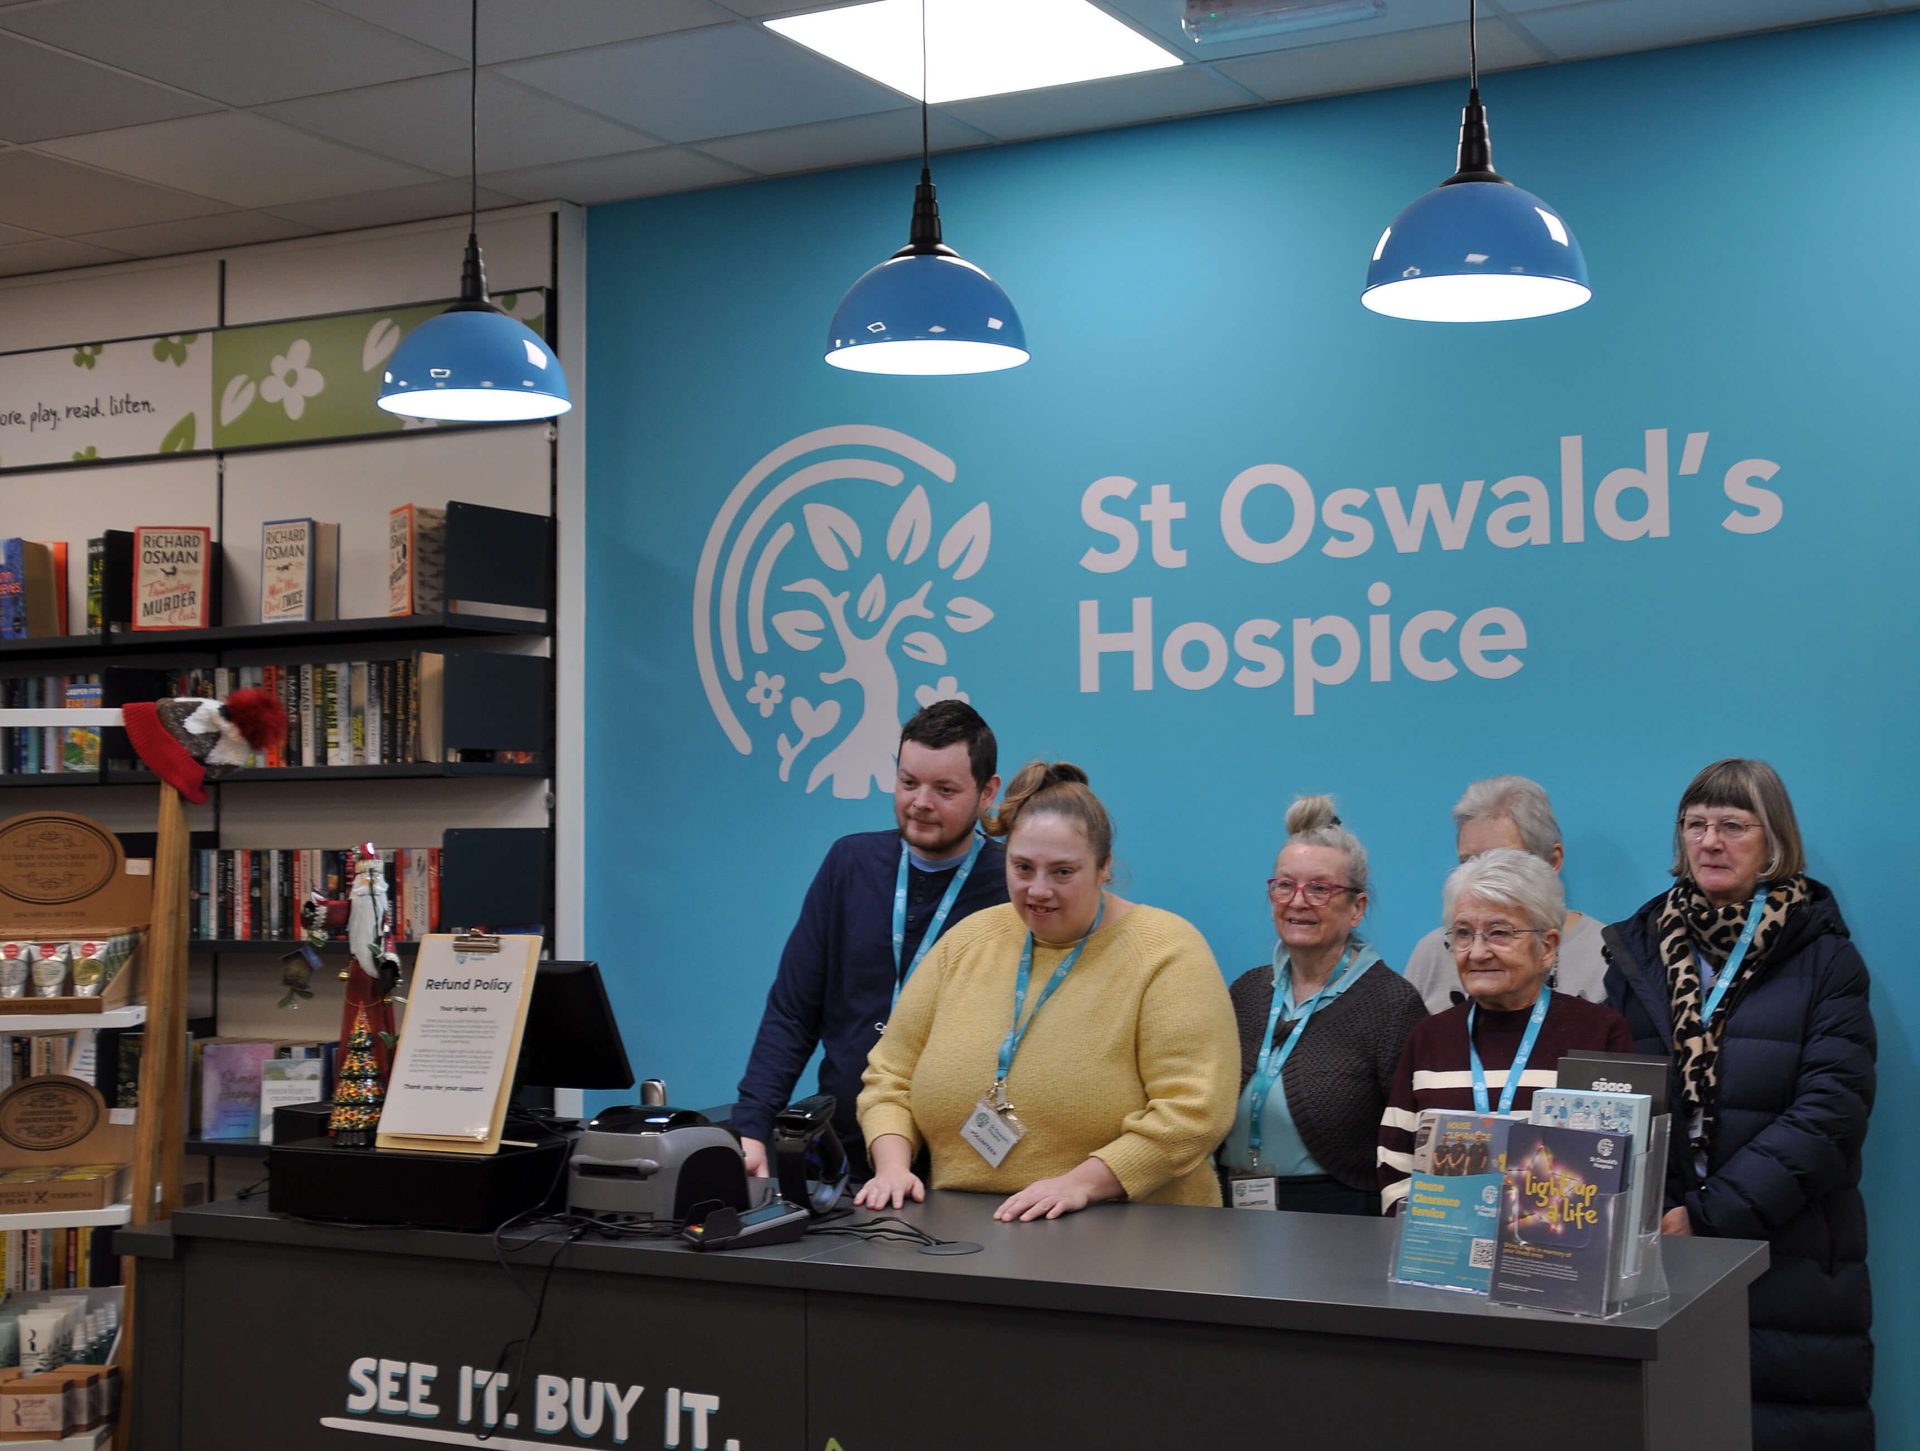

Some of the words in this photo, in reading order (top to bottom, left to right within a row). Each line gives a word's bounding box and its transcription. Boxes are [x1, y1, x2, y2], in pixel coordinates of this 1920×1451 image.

[30, 402, 61, 432] play.
[65, 397, 105, 419] read.
[109, 393, 155, 416] listen.
[1079, 475, 1187, 573] St
[1220, 428, 1784, 564] Oswald's
[143, 551, 199, 564] OSMAN
[265, 544, 305, 560] OSMAN
[142, 591, 196, 617] MURDER
[1079, 581, 1527, 715] Hospice
[326, 670, 338, 694] ANDY
[327, 697, 338, 729] McNAB
[425, 979, 470, 991] Refund
[474, 978, 512, 993] Policy
[470, 1005, 487, 1013] rights
[404, 1083, 421, 1091] Thank
[1592, 1081, 1632, 1092] space
[1525, 1170, 1572, 1208] light
[1572, 1181, 1598, 1201] up
[1410, 1206, 1446, 1219] Service
[1546, 1204, 1559, 1223] a
[1563, 1199, 1598, 1230] life
[347, 1357, 440, 1417] SEE
[457, 1365, 519, 1429] IT.
[535, 1374, 645, 1444] BUY
[664, 1387, 742, 1451] IT.
